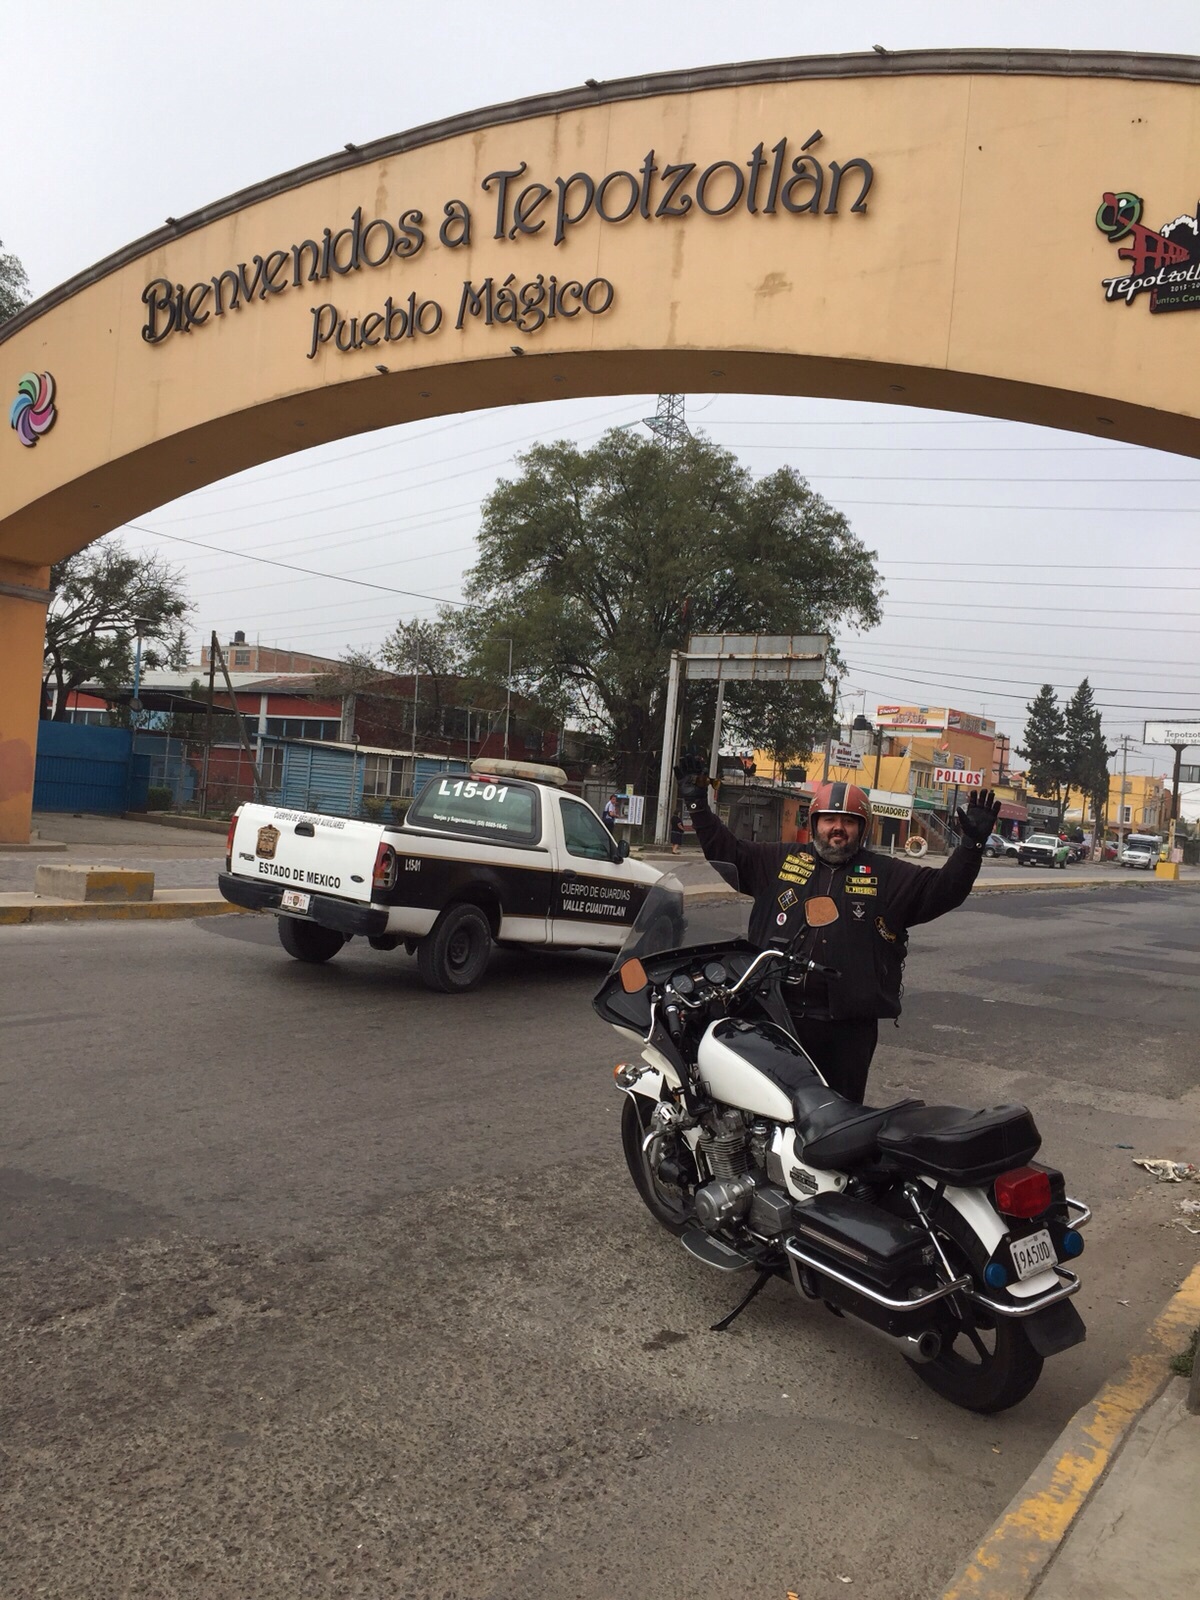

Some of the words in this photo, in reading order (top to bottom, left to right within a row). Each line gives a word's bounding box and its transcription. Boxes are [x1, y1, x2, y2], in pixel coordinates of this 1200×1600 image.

[142, 206, 424, 344] Bienvenidos
[439, 199, 472, 248] a
[481, 129, 875, 245] Tepotzotlán
[306, 291, 443, 360] Pueblo
[455, 274, 615, 333] Mágico
[936, 769, 981, 786] POLLOS
[438, 779, 509, 803] L15-01
[872, 804, 910, 818] RADIADORES
[258, 861, 291, 879] ESTADO
[293, 868, 304, 881] DE
[306, 871, 341, 889] MEXICO
[561, 882, 589, 896] CUERPO
[589, 886, 600, 898] DE
[599, 887, 631, 901] GUARDIAS
[562, 899, 585, 912] VALLE
[585, 902, 626, 917] CUAUTITLAN
